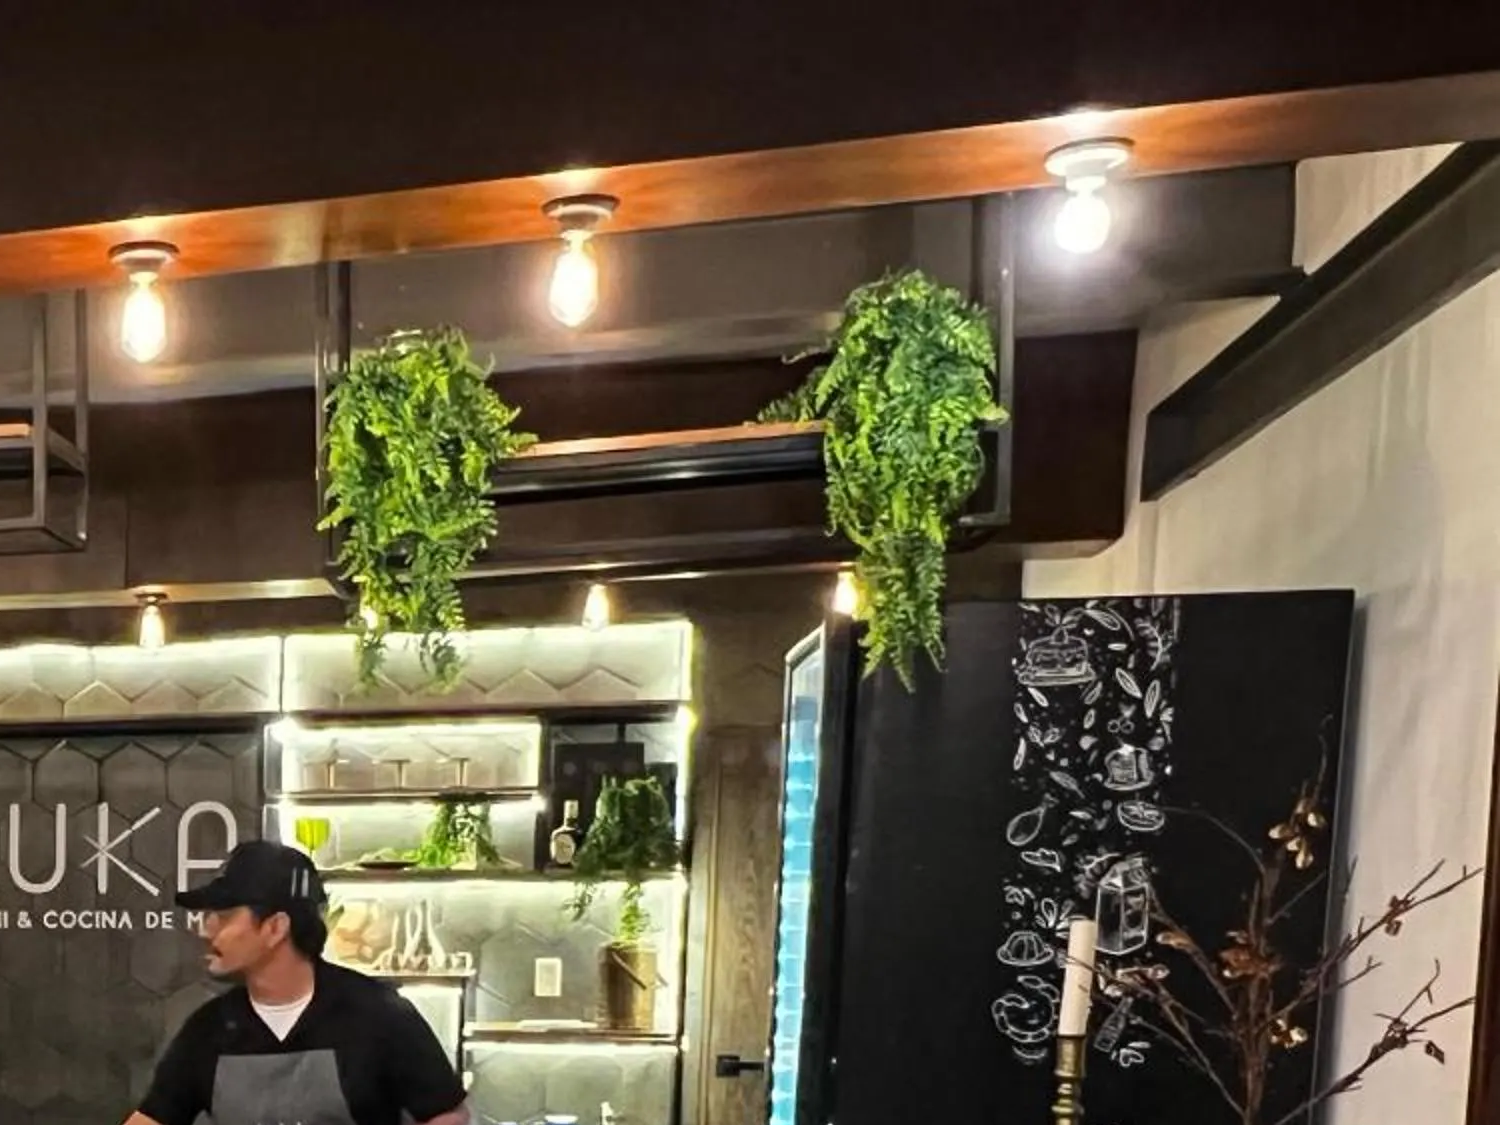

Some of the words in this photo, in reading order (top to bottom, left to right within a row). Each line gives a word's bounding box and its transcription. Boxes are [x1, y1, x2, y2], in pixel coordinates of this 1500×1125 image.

[17, 911, 32, 929] &
[43, 910, 133, 929] COCINA
[145, 911, 174, 929] DE
